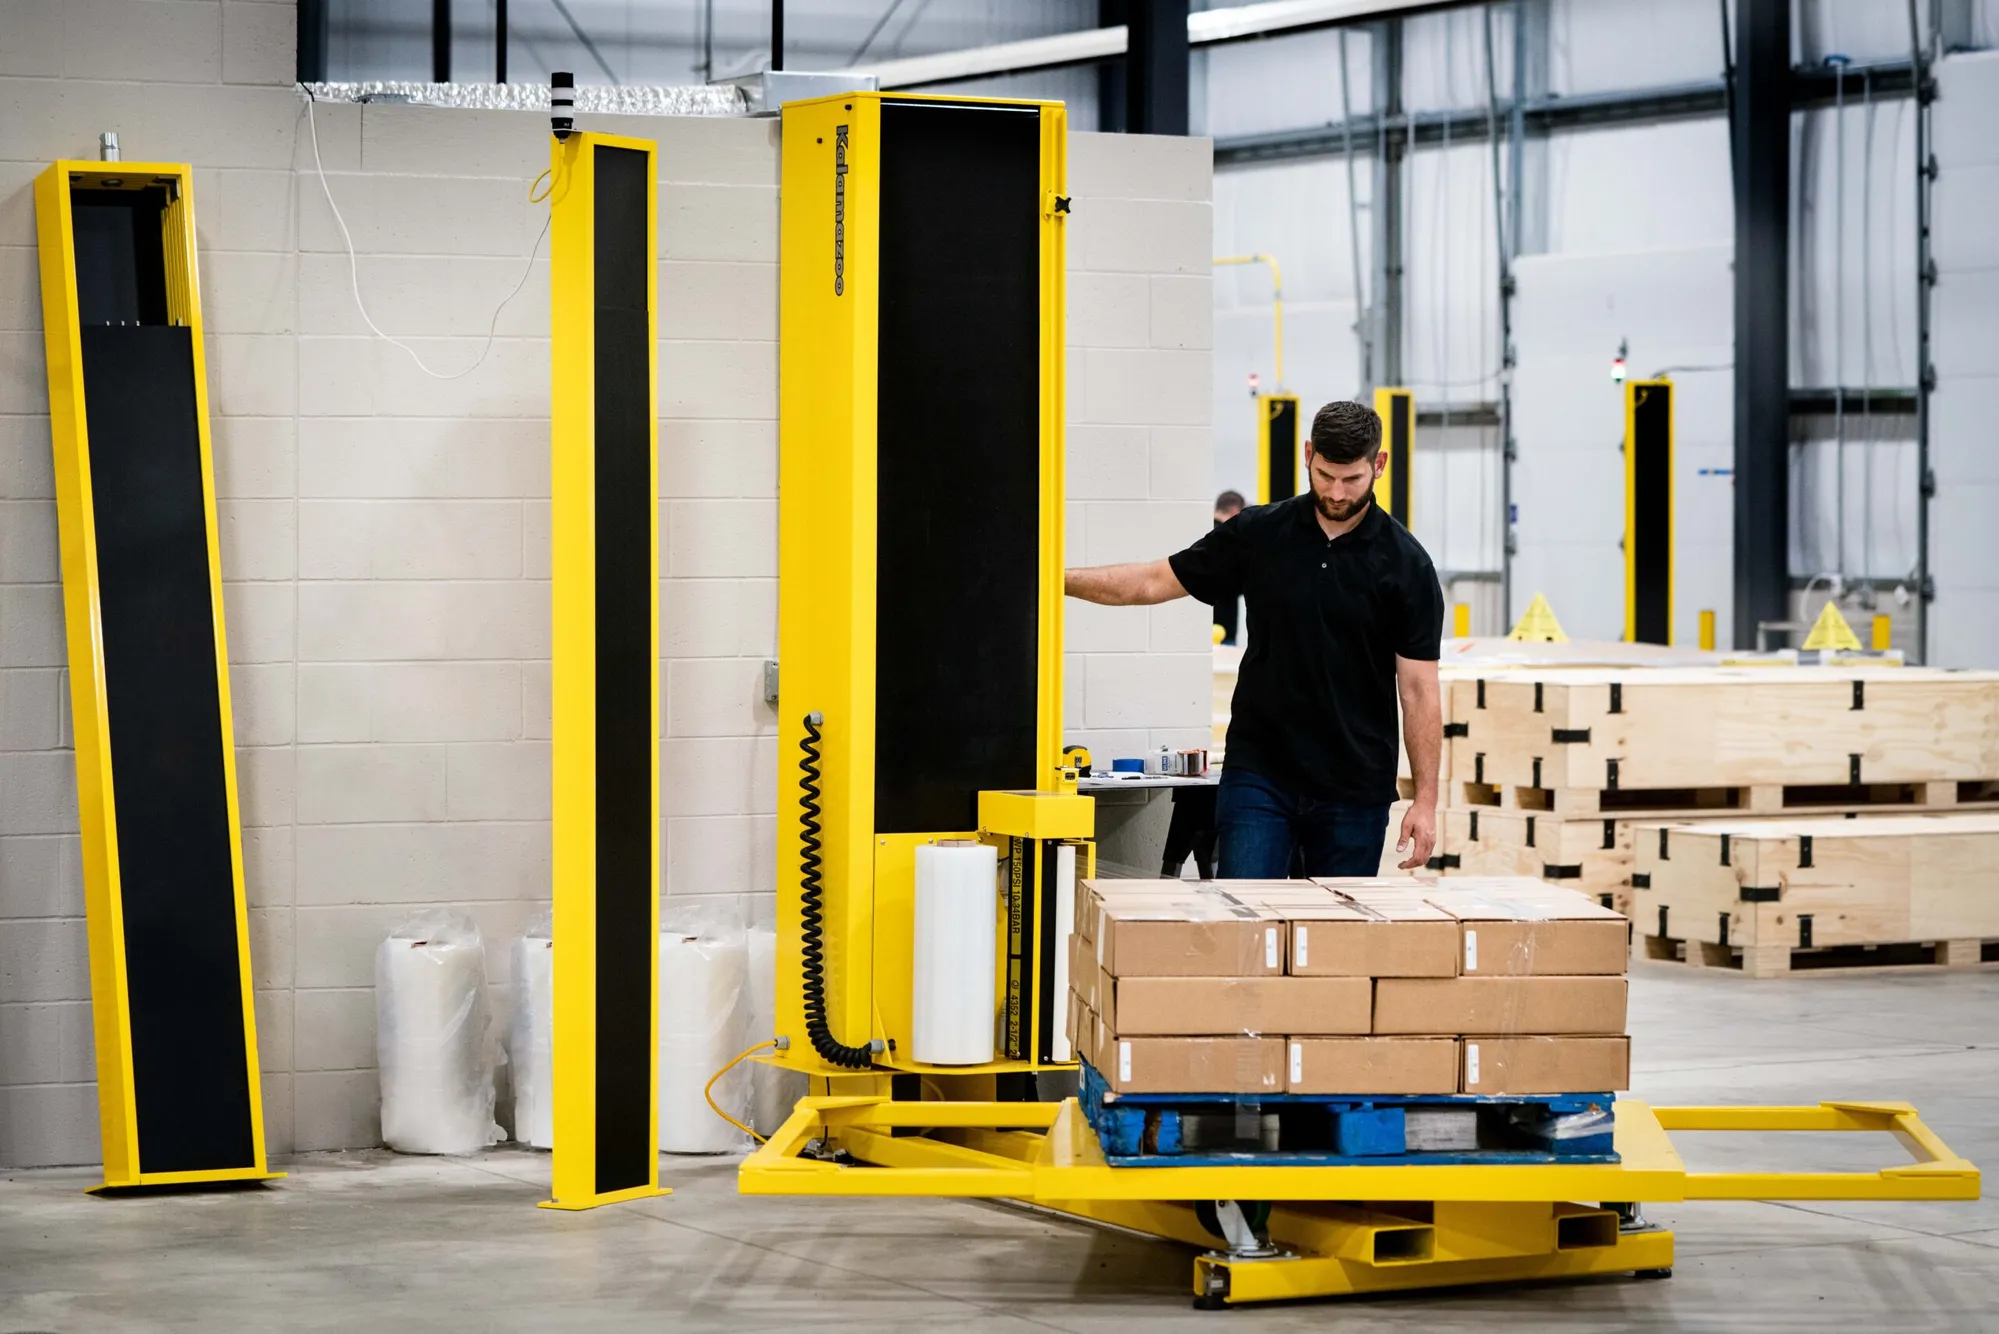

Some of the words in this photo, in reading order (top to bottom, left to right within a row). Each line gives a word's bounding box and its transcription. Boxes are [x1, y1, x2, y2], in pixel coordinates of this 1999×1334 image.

[835, 124, 849, 296] Kalamazoo
[1013, 857, 1022, 888] 150PSI
[1010, 994, 1019, 1016] 4352
